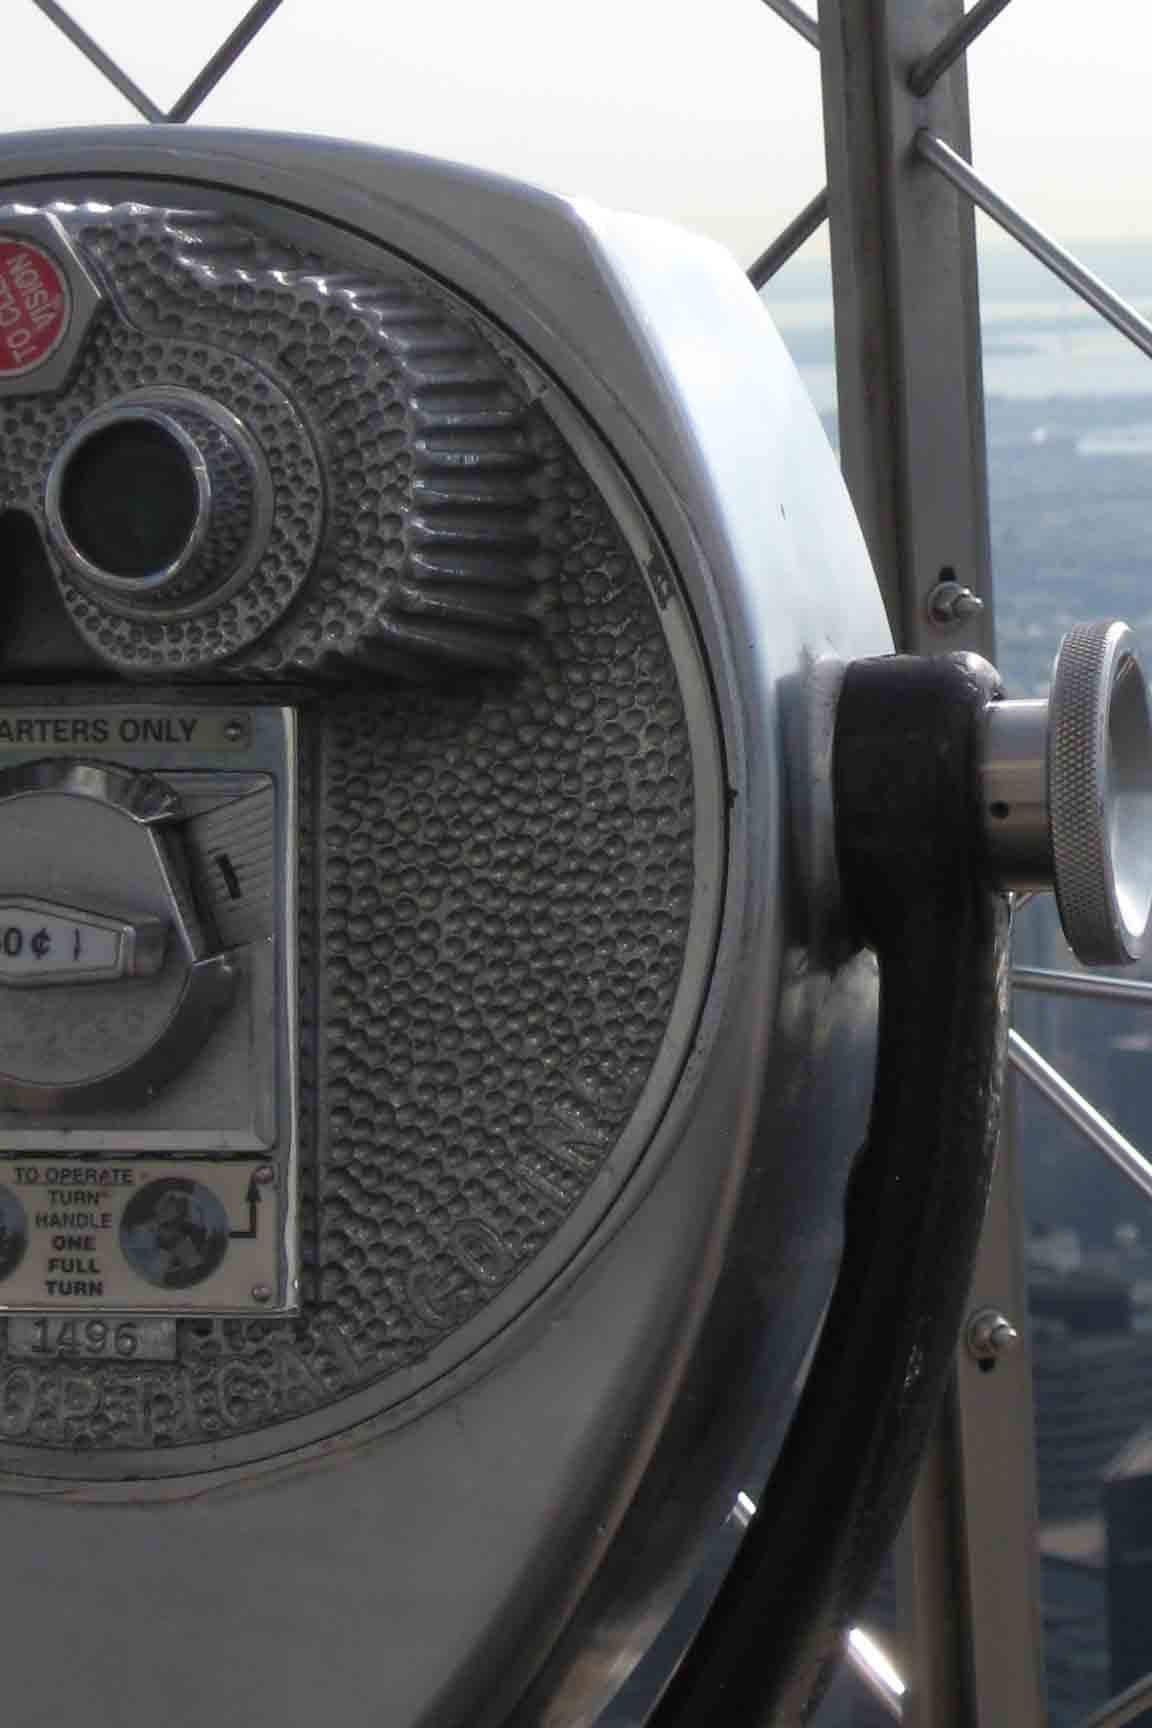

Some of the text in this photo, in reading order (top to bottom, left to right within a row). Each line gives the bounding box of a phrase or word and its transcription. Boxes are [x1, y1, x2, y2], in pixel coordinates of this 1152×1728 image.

[119, 718, 198, 743] ONLY
[0, 926, 52, 960] 0¢
[15, 1167, 135, 1185] TO OPERATE
[48, 1190, 99, 1206] TURN
[35, 1212, 112, 1229] HANDLE
[52, 1234, 97, 1251] ONE
[48, 1256, 101, 1274] FULL
[45, 1279, 104, 1297] TURN
[32, 1317, 138, 1357] 1496
